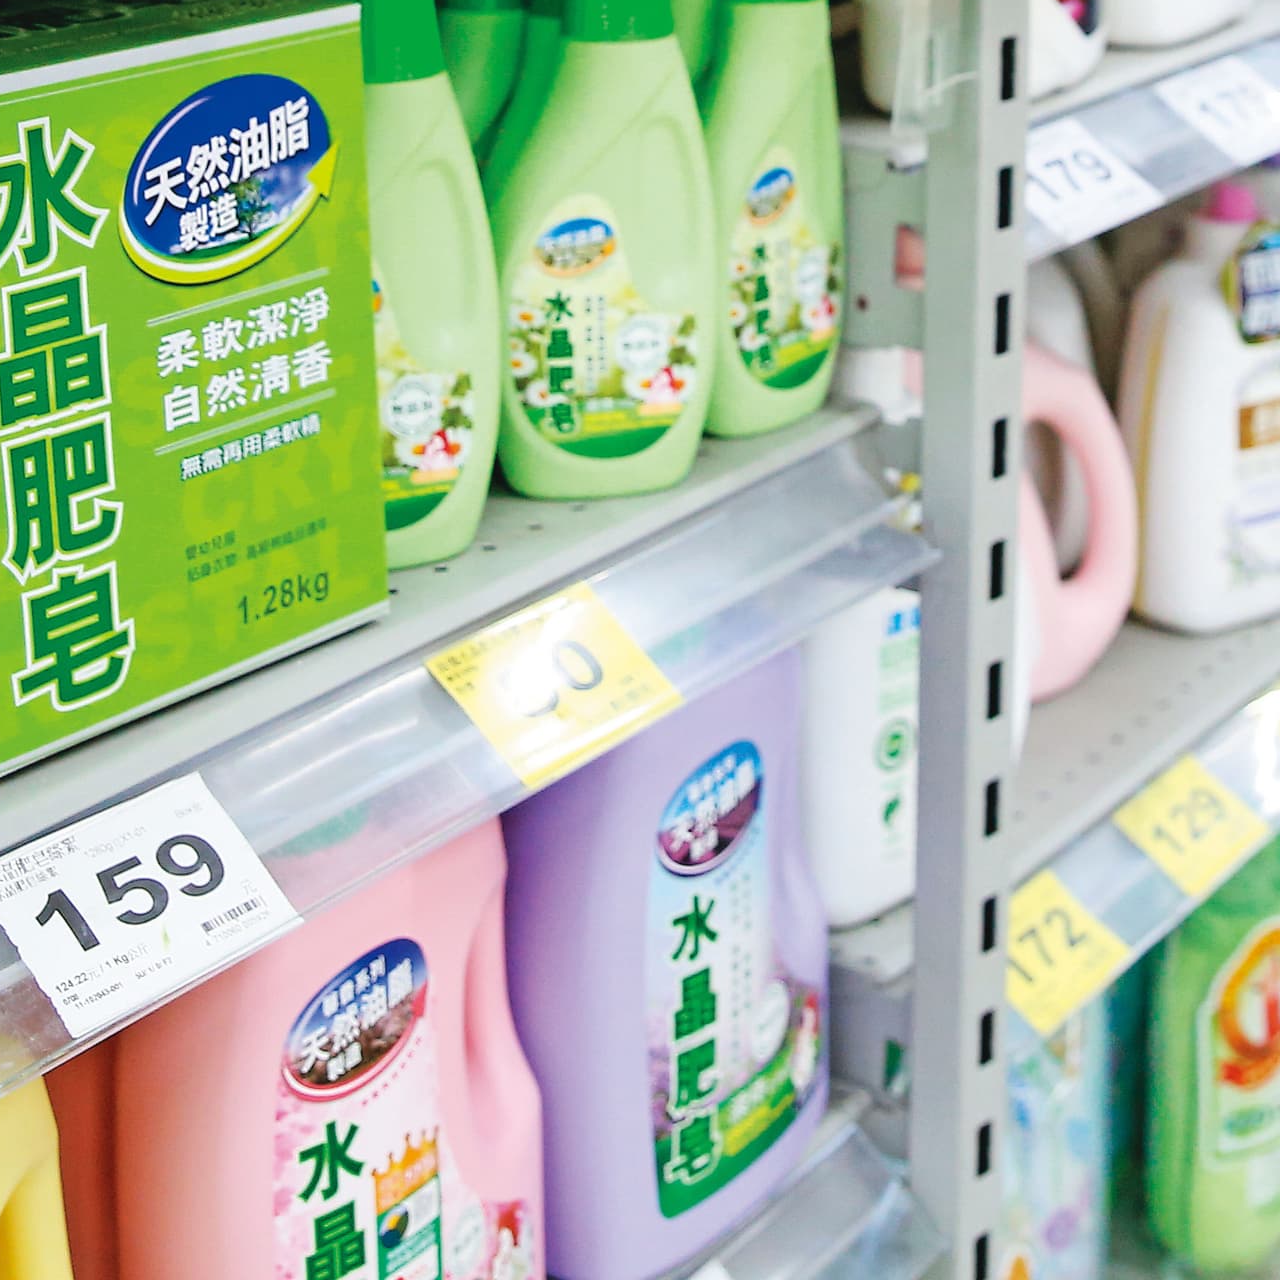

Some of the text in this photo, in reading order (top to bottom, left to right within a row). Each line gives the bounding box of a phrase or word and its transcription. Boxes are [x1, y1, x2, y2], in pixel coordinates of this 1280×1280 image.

[143, 96, 310, 226] 天然油脂
[1028, 149, 1111, 200] 179
[179, 191, 239, 252] 製造
[157, 286, 330, 380] 柔軟潔淨
[163, 341, 333, 433] 自然清香
[181, 414, 321, 482] 無需再用柔軟精
[238, 571, 329, 625] 1.28kg
[1152, 787, 1227, 854] 129
[35, 834, 224, 952] 159
[1008, 907, 1088, 982] 172
[666, 895, 718, 1184] 水晶肥皂
[297, 1120, 366, 1280] 水晶
